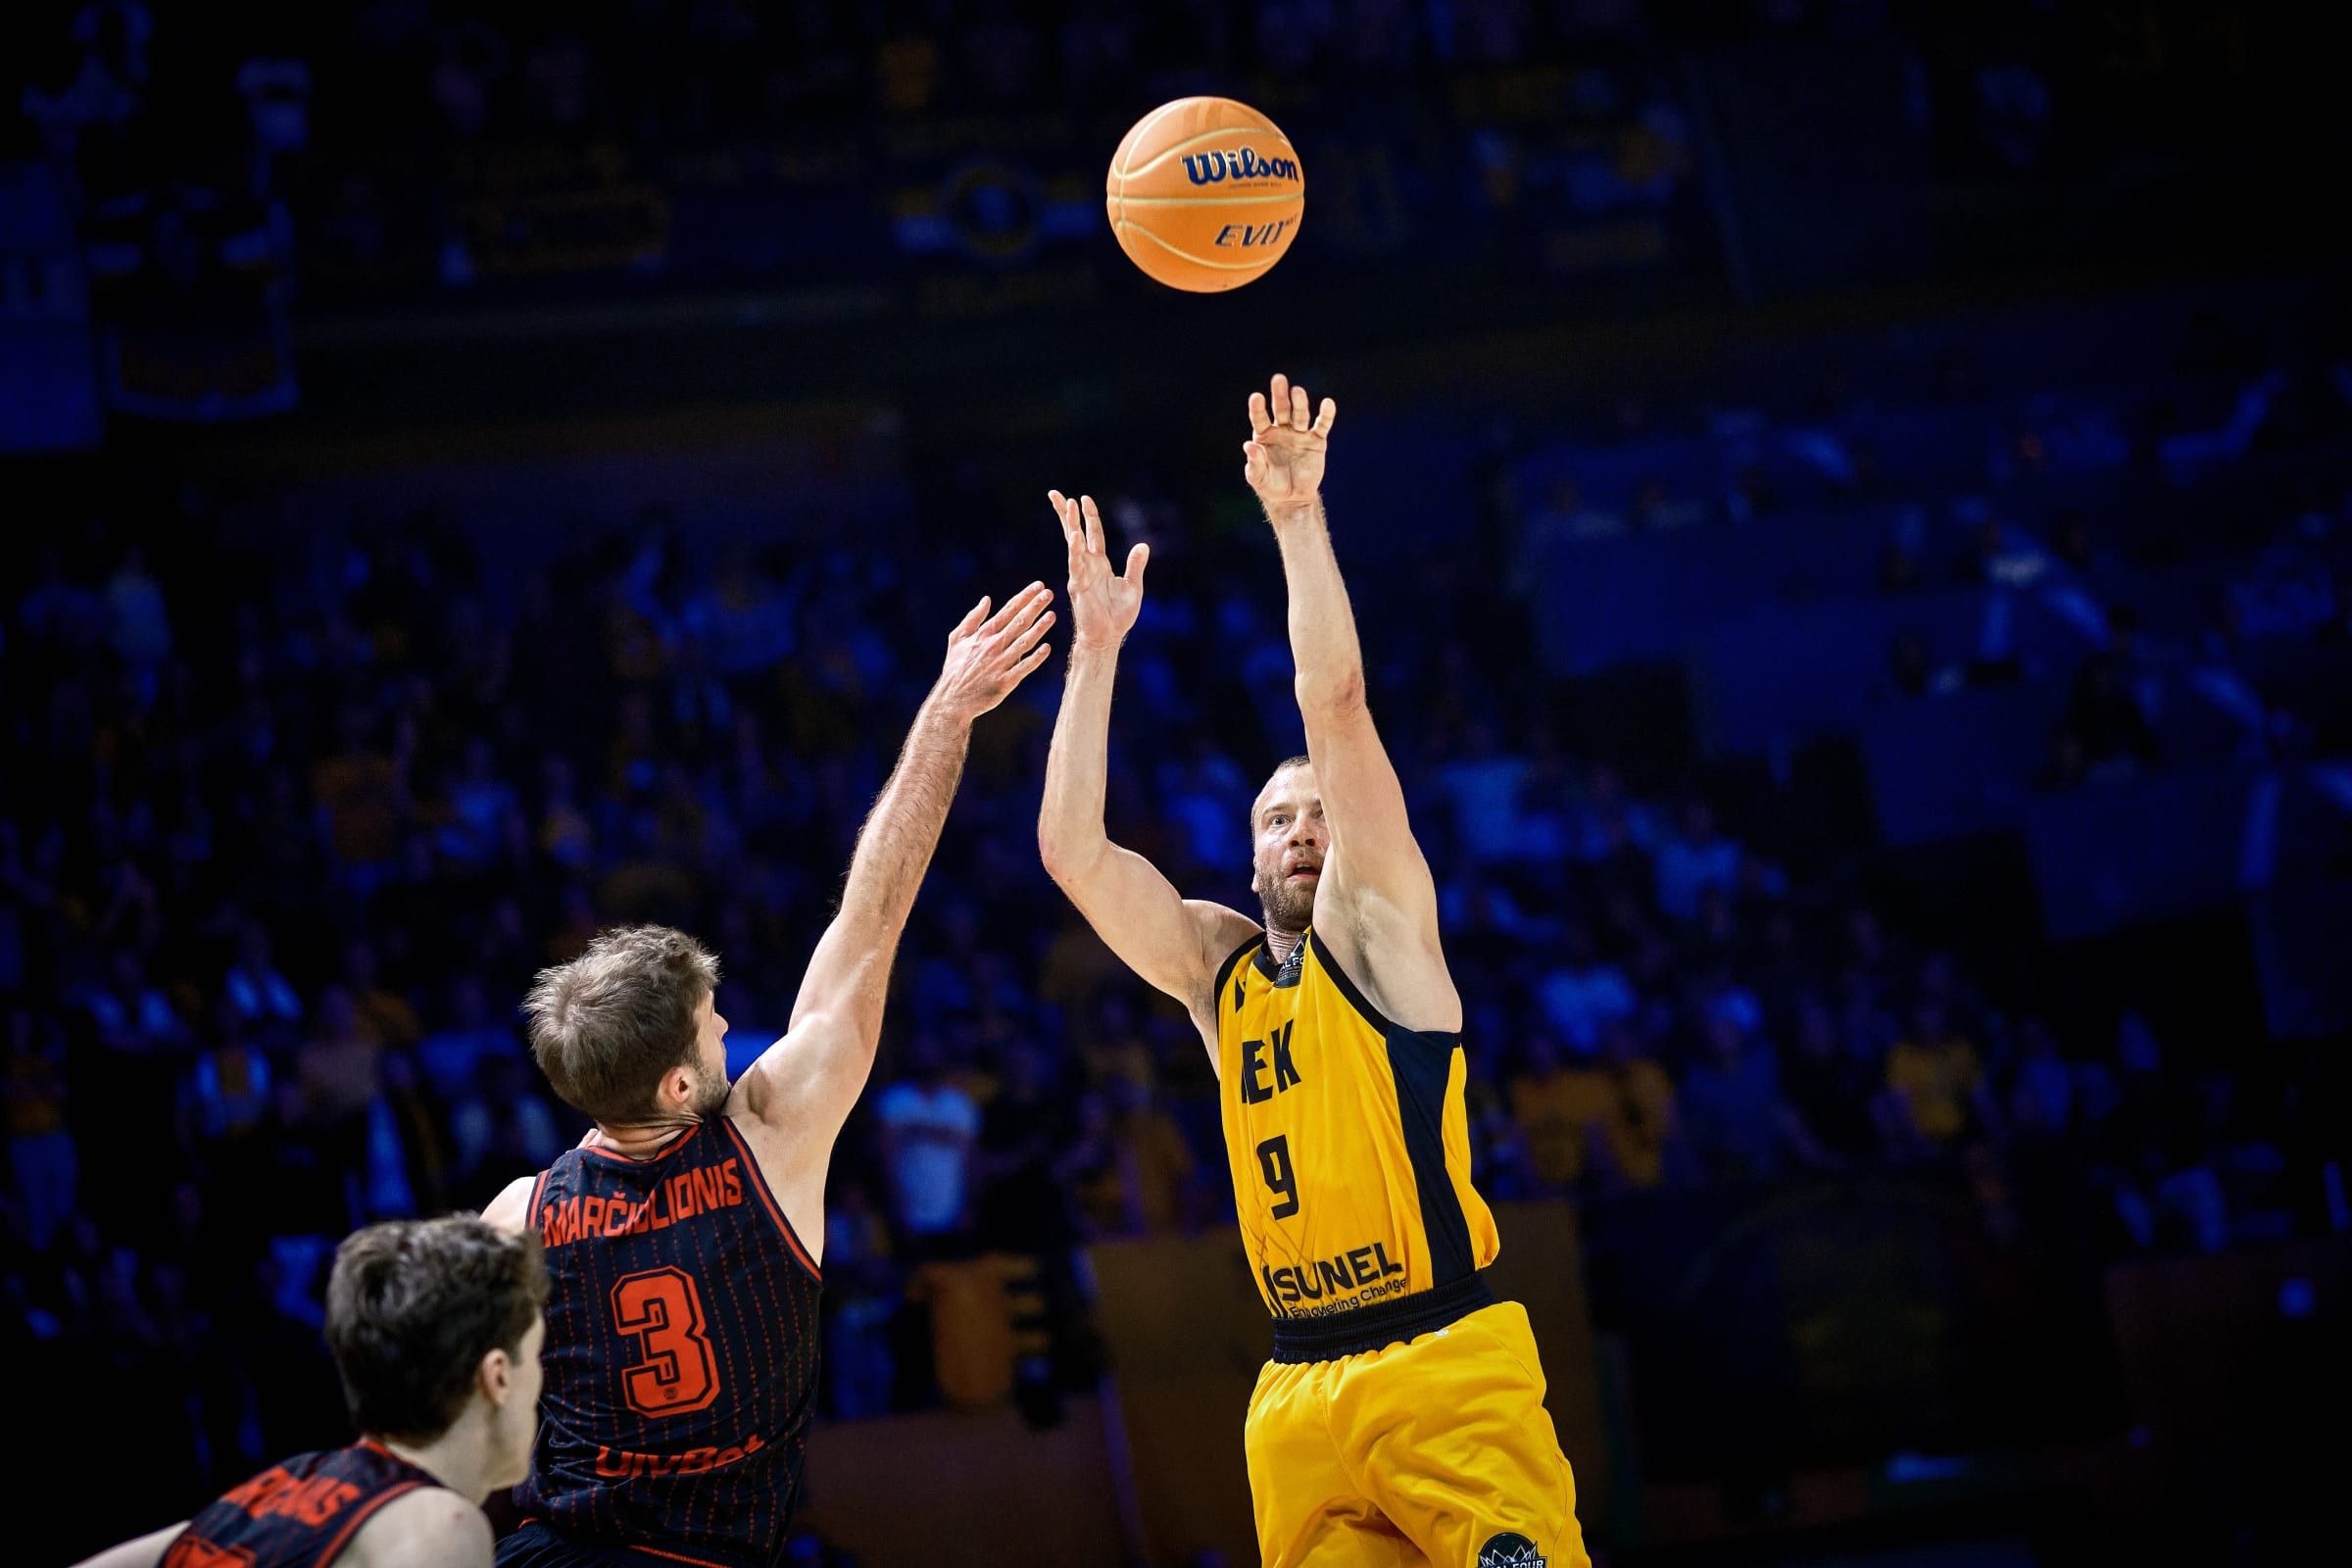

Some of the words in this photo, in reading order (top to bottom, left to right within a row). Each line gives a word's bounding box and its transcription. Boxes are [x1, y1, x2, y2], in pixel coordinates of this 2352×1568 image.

[1181, 147, 1299, 185] Wilson
[1214, 220, 1284, 247] EVO
[1241, 1018, 1302, 1105] EK
[1256, 1134, 1299, 1221] 9
[1273, 1242, 1404, 1301] SUNEL
[1360, 1278, 1406, 1301] Change
[611, 1264, 721, 1418] 3
